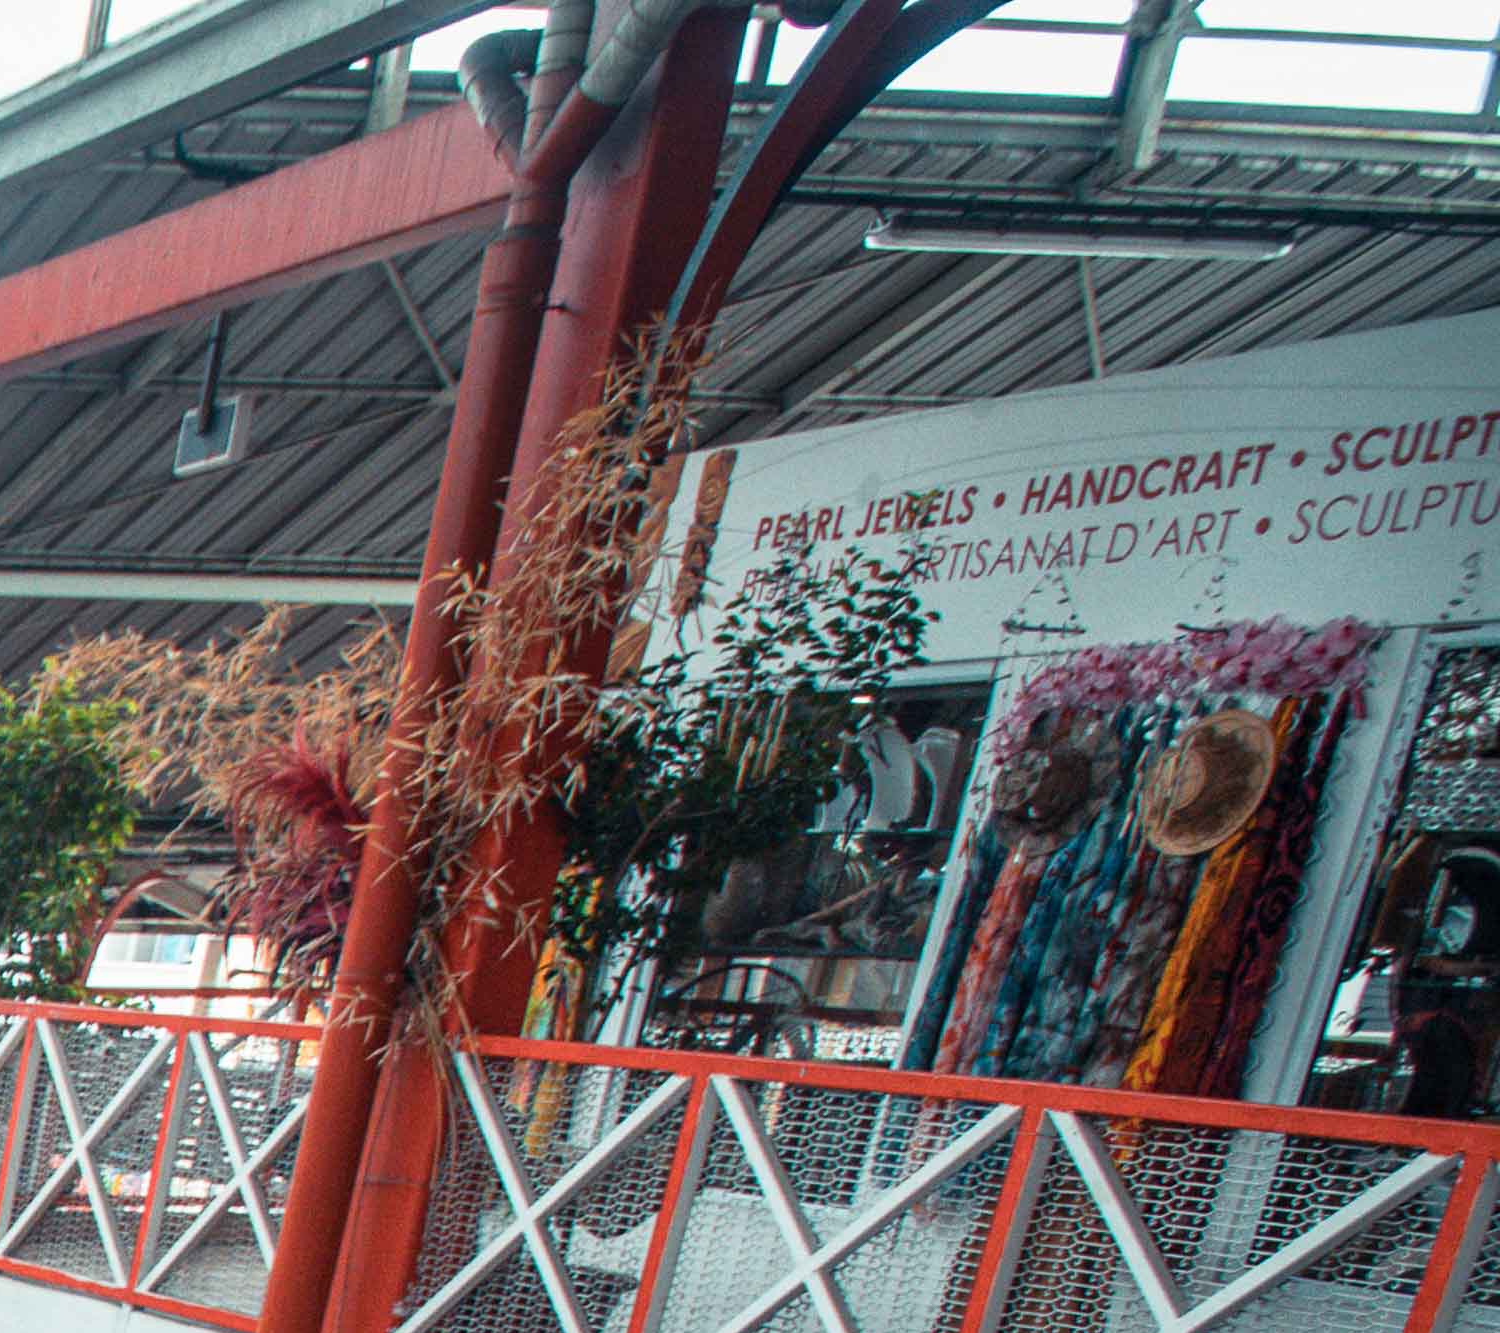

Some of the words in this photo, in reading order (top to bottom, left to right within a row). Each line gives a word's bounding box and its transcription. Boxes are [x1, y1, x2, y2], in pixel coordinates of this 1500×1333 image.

[753, 505, 845, 551] PEARL
[854, 484, 979, 538] JEWELS
[1019, 443, 1276, 516] HANDCRAFT
[1103, 508, 1243, 565] D'ART
[1287, 477, 1500, 546] SCULPTU
